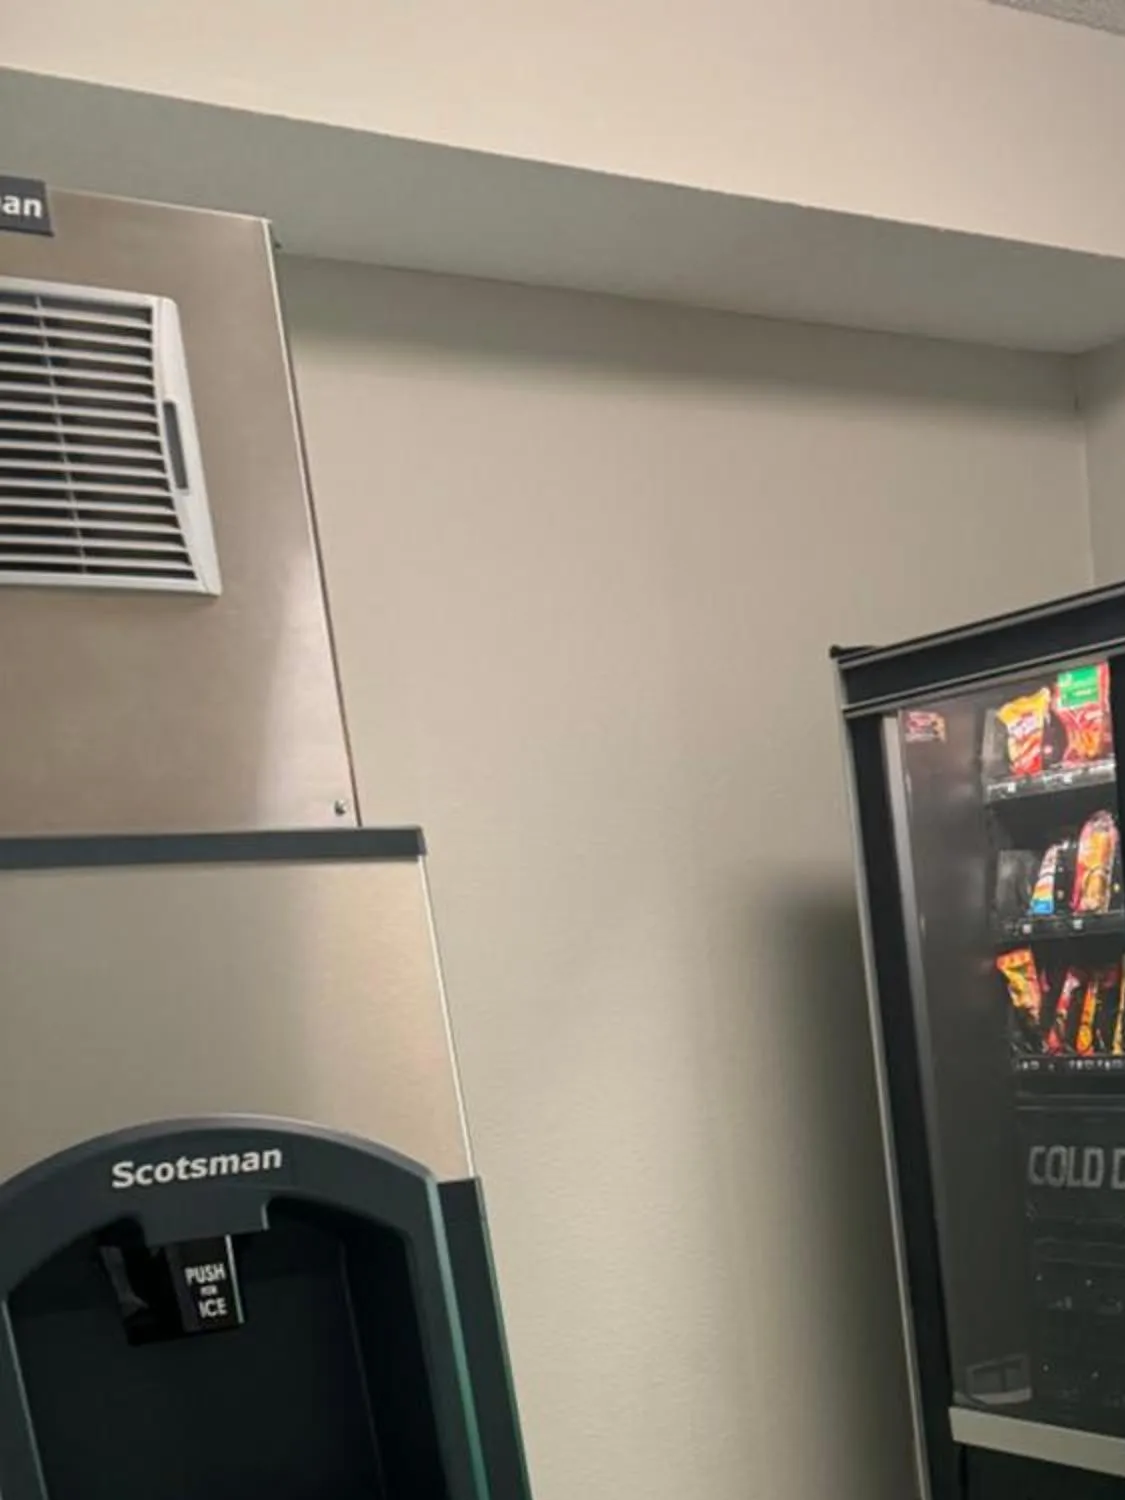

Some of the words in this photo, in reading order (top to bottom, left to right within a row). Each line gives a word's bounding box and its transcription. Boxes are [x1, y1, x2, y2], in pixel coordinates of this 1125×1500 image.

[112, 1148, 283, 1189] Scotsman
[1028, 1145, 1105, 1188] COLD
[184, 1262, 226, 1287] PUSH
[198, 1297, 228, 1319] ICE
